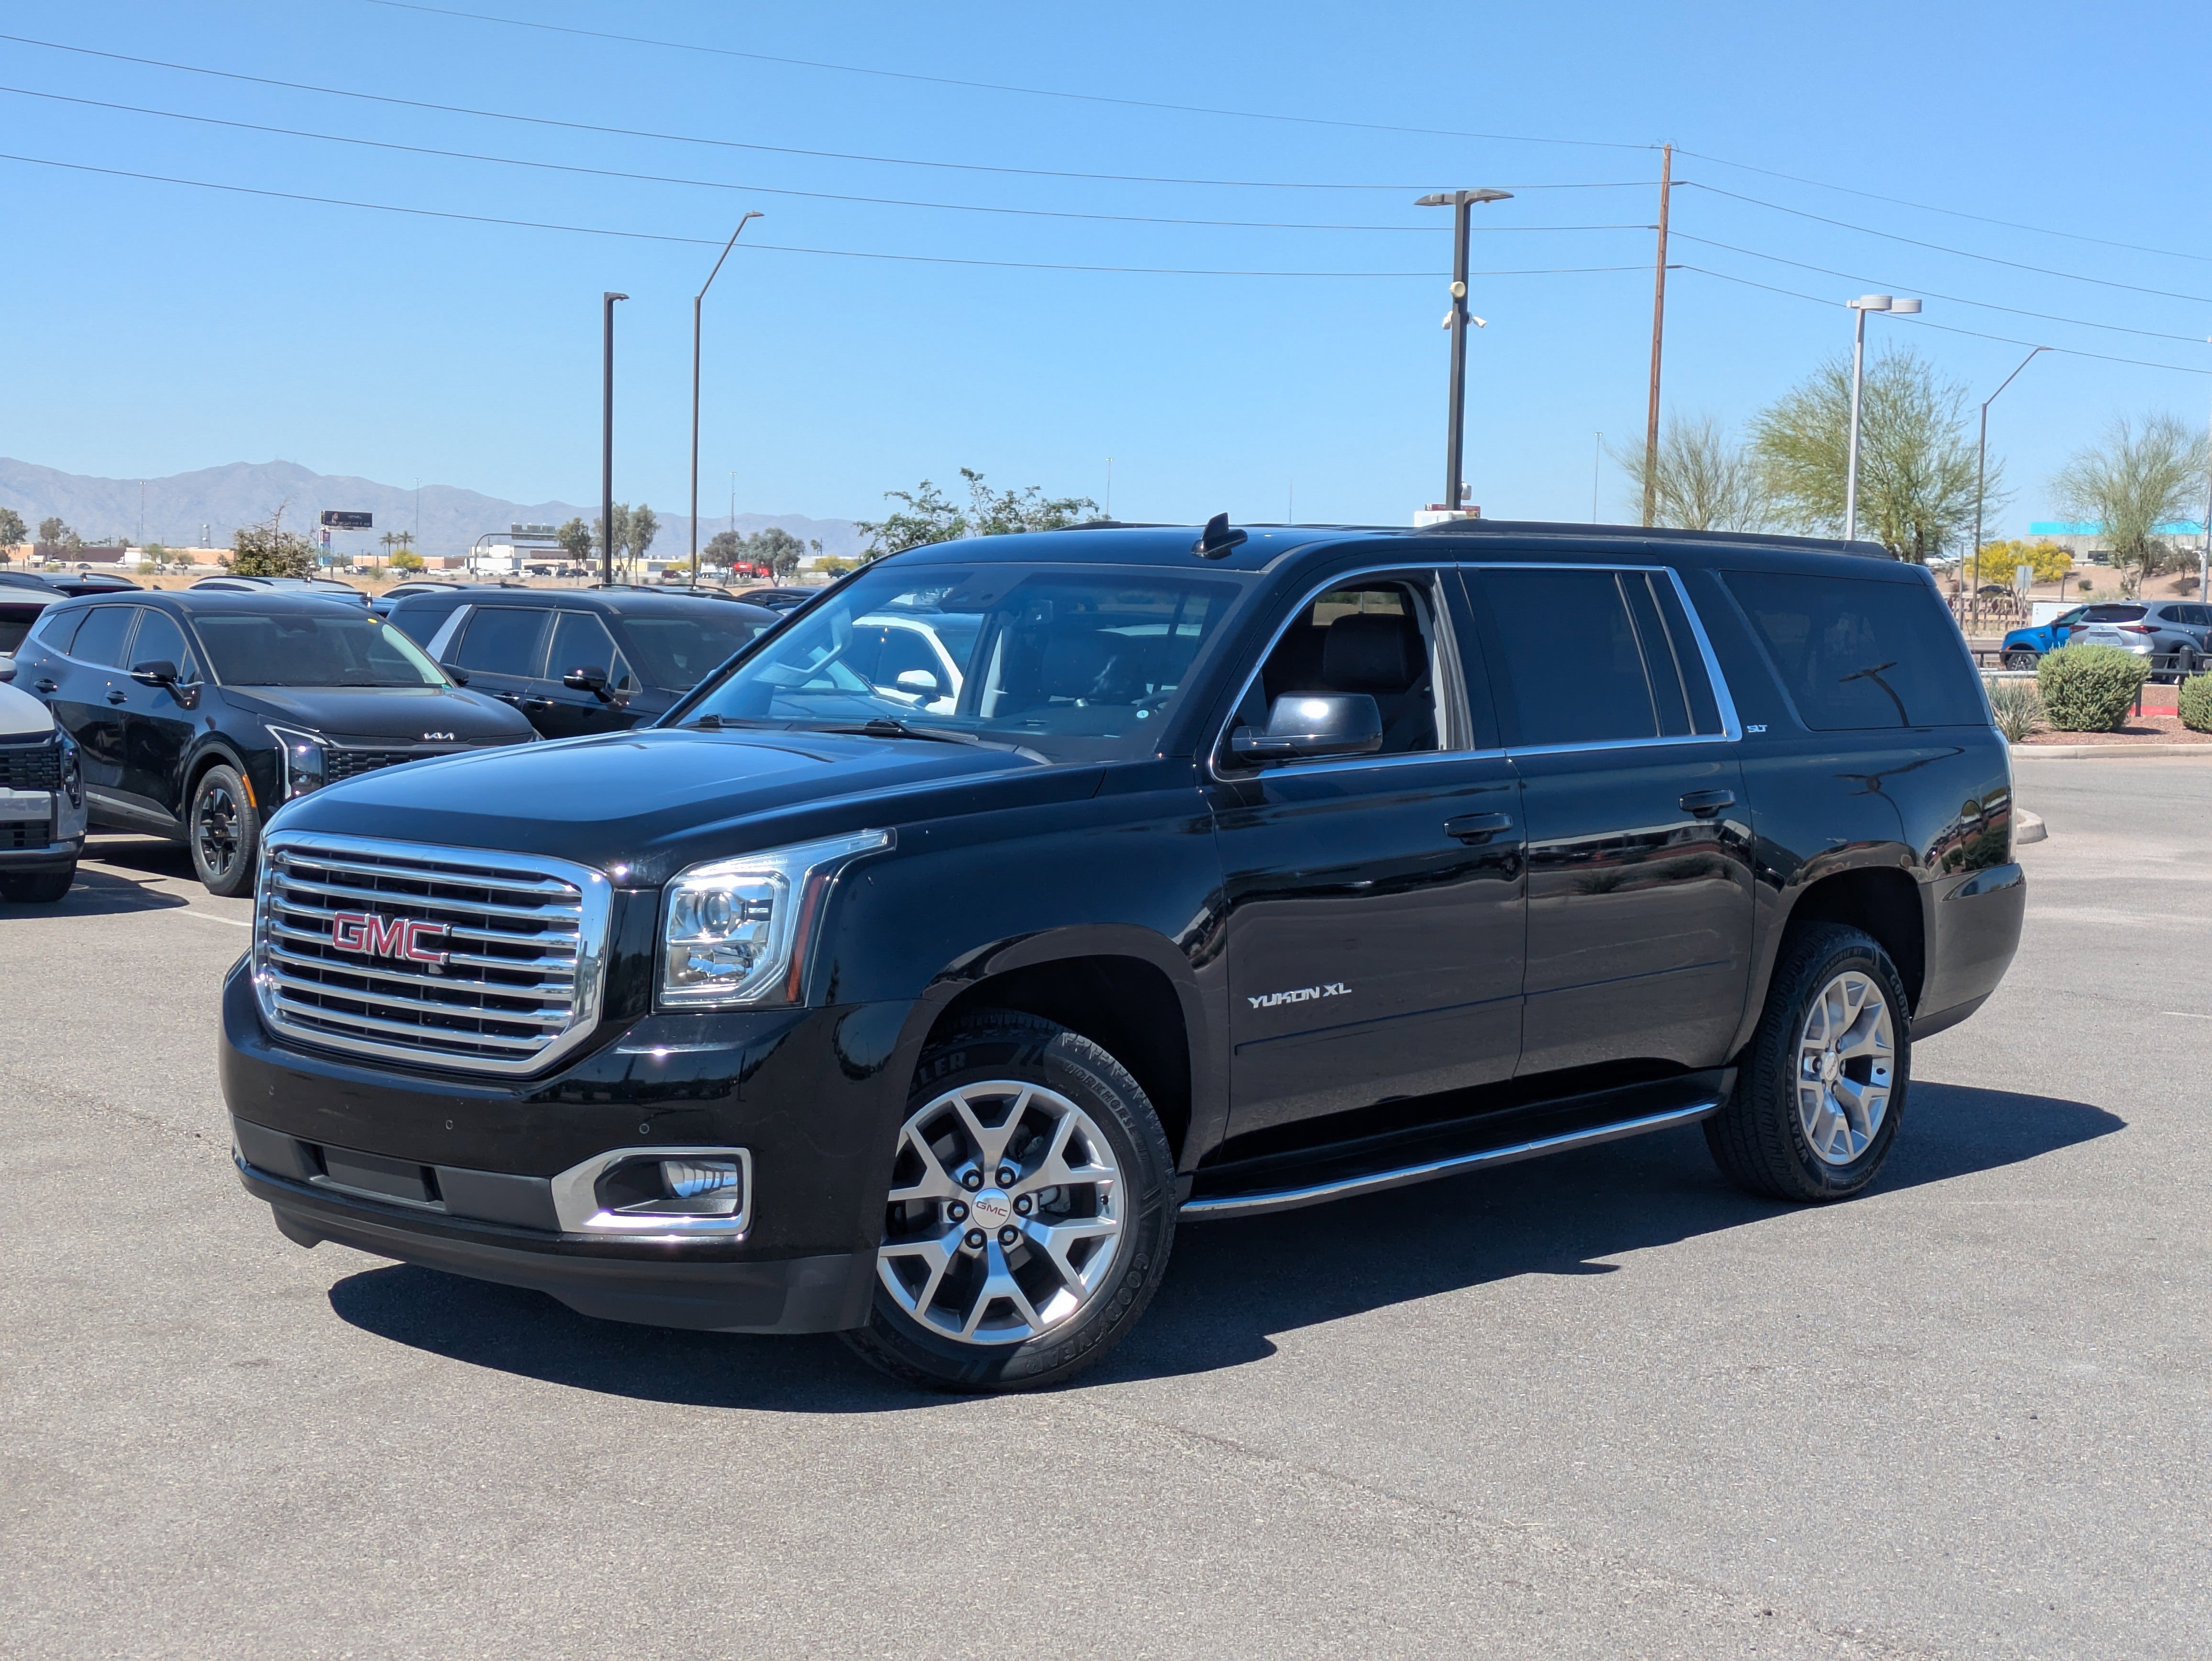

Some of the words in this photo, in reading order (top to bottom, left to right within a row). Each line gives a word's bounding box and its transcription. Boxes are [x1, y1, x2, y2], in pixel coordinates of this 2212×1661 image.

[1747, 724, 1768, 732] SLT
[333, 910, 451, 965] GMC
[1247, 986, 1320, 1008] YUKON
[1323, 983, 1352, 997] XL
[1064, 1062, 1140, 1135] WORKHORSE
[976, 1200, 1008, 1217] GMC
